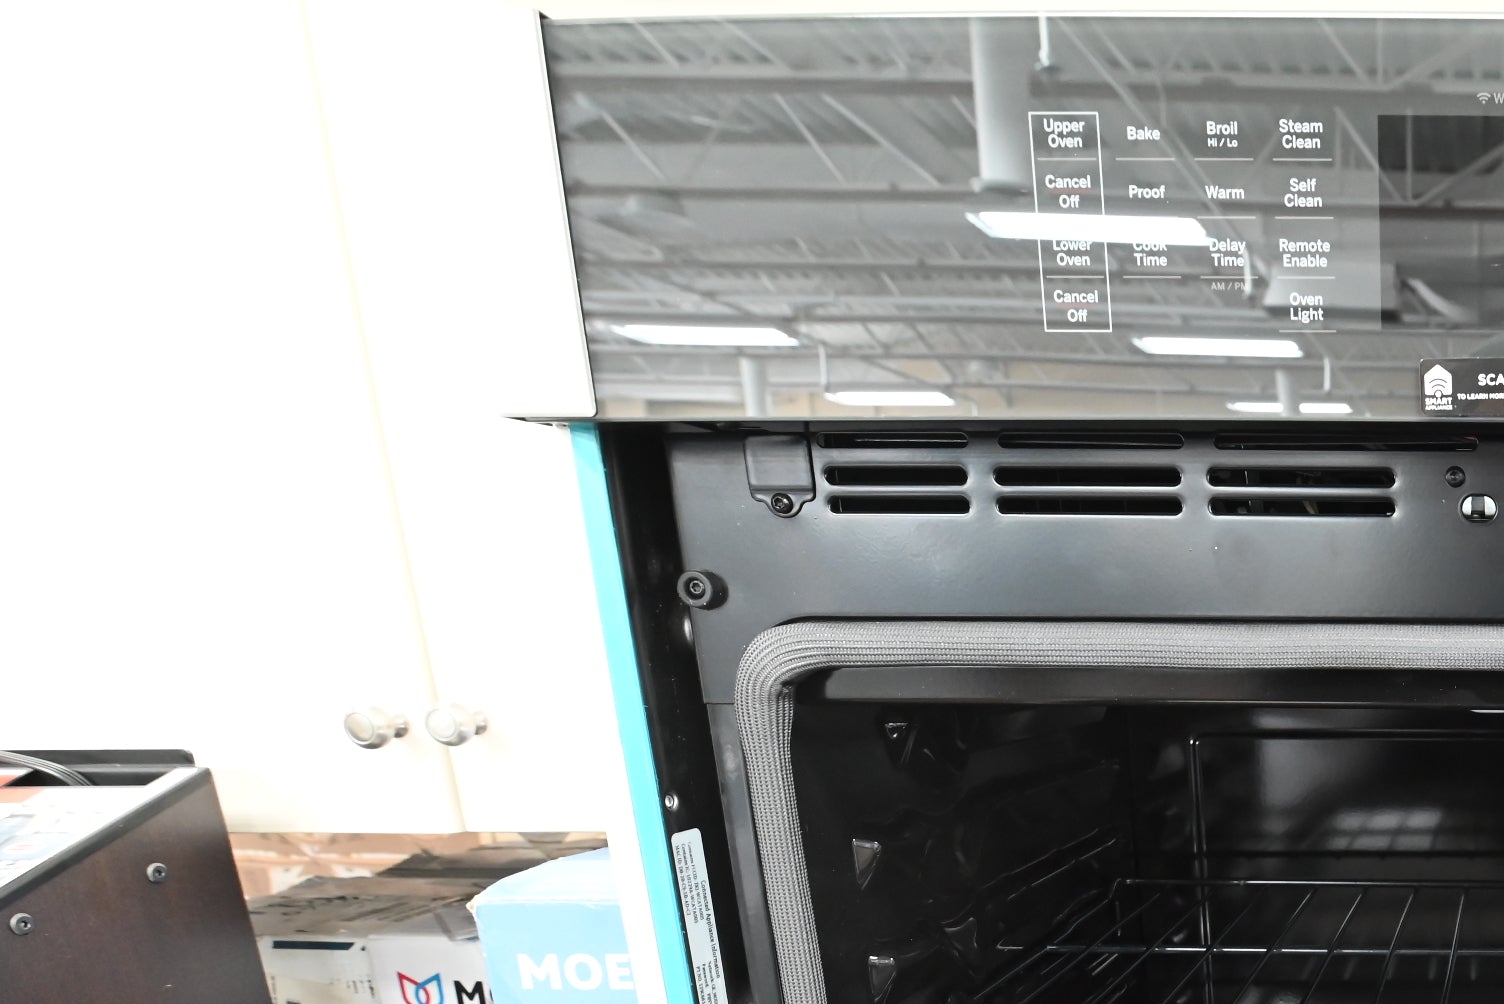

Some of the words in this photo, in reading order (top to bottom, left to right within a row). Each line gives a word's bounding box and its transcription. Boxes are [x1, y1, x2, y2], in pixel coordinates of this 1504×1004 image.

[1043, 118, 1085, 135] Upper
[1126, 126, 1161, 141] Bake
[1206, 121, 1238, 135] Broil
[1278, 119, 1323, 134] Steam
[1048, 135, 1082, 148] Oven
[1207, 137, 1217, 147] Hi
[1227, 138, 1239, 147] Lo
[1282, 135, 1321, 149] Clean
[1045, 174, 1091, 189] Cancel
[1289, 178, 1316, 193] Self
[1128, 185, 1166, 199] Proof
[1205, 186, 1245, 200] Warm
[1059, 194, 1080, 209] Off
[1284, 194, 1323, 208] Clean
[1052, 239, 1092, 252] Lower
[1132, 241, 1168, 252] Cook
[1209, 238, 1247, 255] Delay
[1279, 238, 1331, 252] Remote
[1056, 253, 1091, 267] Oven
[1134, 253, 1168, 267] Time
[1211, 253, 1245, 267] Time
[1283, 253, 1328, 268] Enable
[1211, 282, 1225, 291] AM
[1053, 289, 1099, 303] Cancel
[1289, 293, 1323, 306] Oven
[1067, 308, 1088, 322] Off
[1290, 307, 1324, 324] Light
[1425, 397, 1453, 405] SMART
[700, 880, 710, 912] Connected
[706, 913, 715, 943] Appliance
[711, 943, 721, 979] Information
[516, 953, 634, 991] MOE
